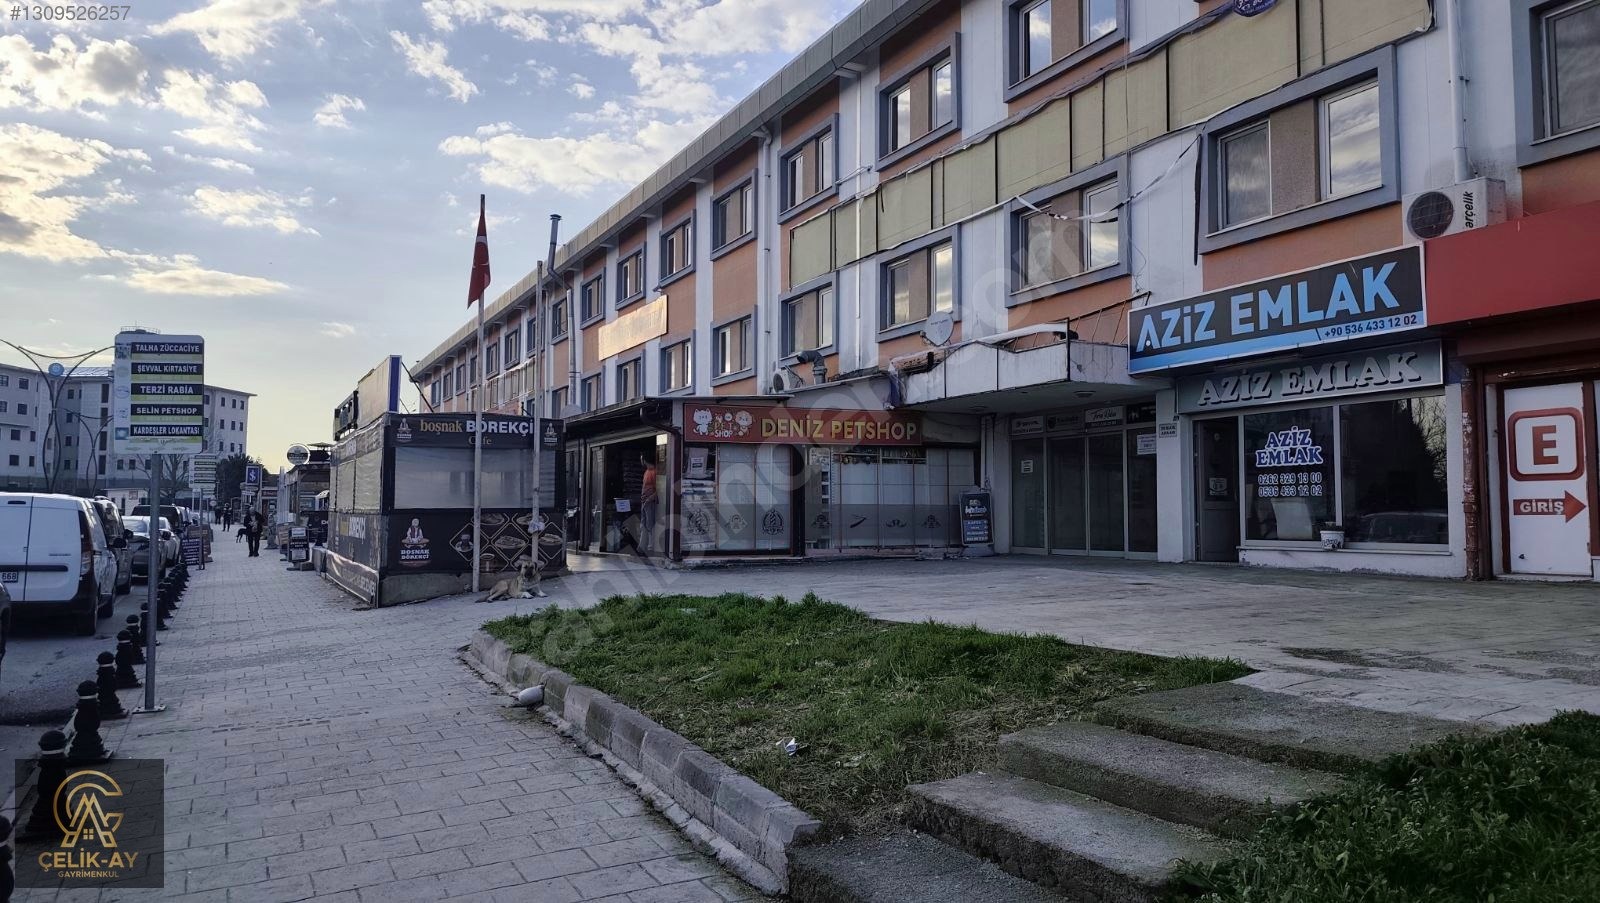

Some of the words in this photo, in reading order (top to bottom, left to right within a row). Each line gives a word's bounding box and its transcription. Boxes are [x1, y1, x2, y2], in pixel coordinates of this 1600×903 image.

[1462, 191, 1476, 229] arçelik
[1230, 261, 1400, 336] EMLAK
[1324, 327, 1343, 337] +90
[1345, 323, 1364, 335] 536
[1366, 320, 1385, 332] 433
[1388, 317, 1401, 328] 12
[1403, 314, 1417, 325] 02
[135, 344, 158, 352] TALHA
[137, 365, 162, 373] ŞEVVAL
[1198, 368, 1272, 406] AZİZ
[1280, 351, 1422, 397] EMLAK
[140, 384, 166, 394] TERZİ
[167, 385, 194, 394] RABİA
[136, 406, 160, 414] SELİN
[420, 419, 463, 436] boşnak
[714, 429, 734, 438] SHOP
[761, 414, 824, 439] DENİZ
[831, 419, 917, 441] PETSHOP
[468, 436, 492, 446] Cfe
[1265, 425, 1312, 449] AZİZ
[1532, 425, 1559, 465] E
[1256, 446, 1324, 467] EMLAK
[1258, 473, 1279, 485] 0262
[1280, 472, 1296, 484] 329
[1298, 472, 1309, 484] 13
[1310, 472, 1322, 484] 00
[1258, 486, 1279, 497] 0536
[1281, 485, 1296, 497] 433
[1298, 485, 1309, 496] 12
[1311, 484, 1323, 496] 02
[1519, 498, 1564, 515] GİRİŞ
